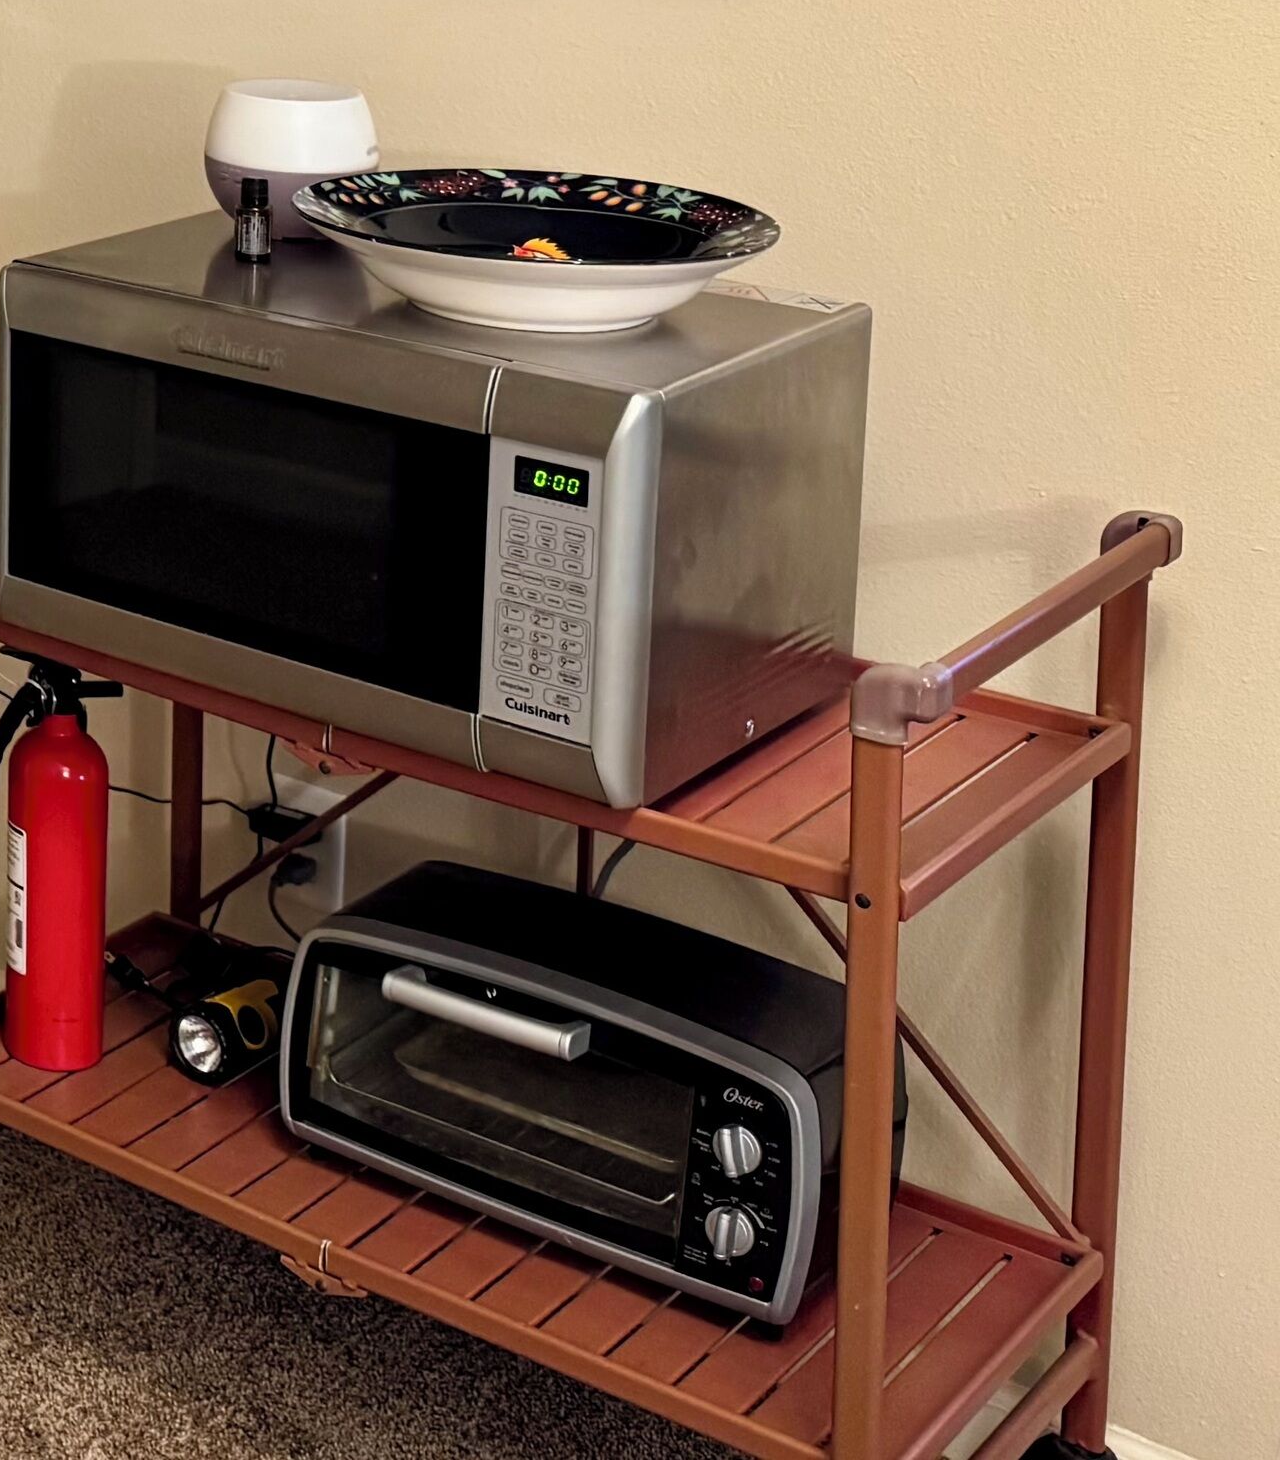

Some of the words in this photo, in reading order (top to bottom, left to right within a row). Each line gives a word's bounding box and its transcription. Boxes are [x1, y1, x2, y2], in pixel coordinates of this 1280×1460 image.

[533, 470, 580, 495] 0:00
[504, 696, 572, 726] Cuisinart
[722, 1086, 765, 1111] Oster
